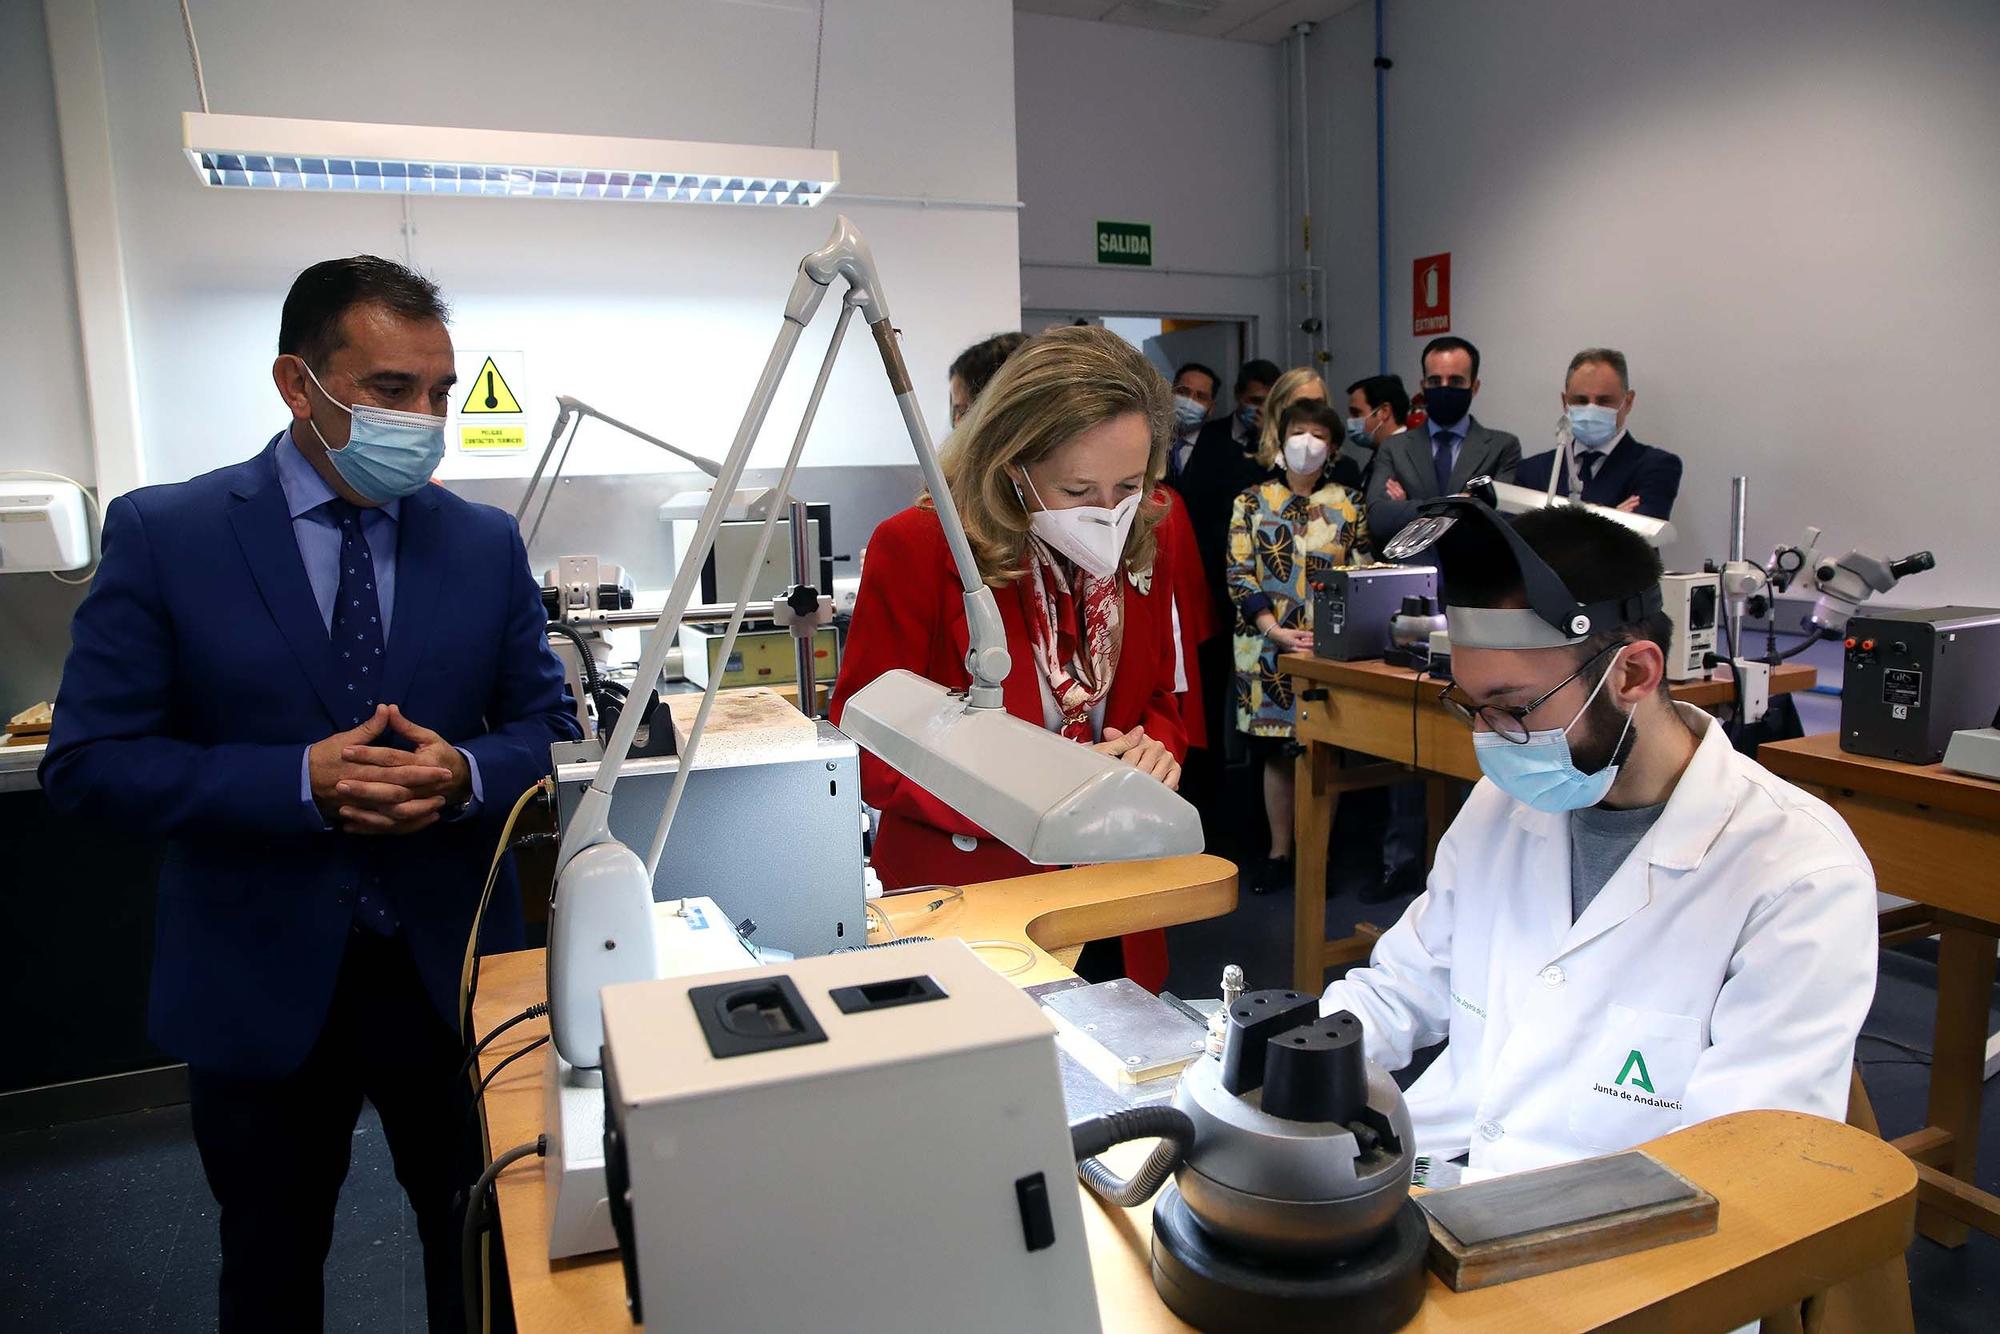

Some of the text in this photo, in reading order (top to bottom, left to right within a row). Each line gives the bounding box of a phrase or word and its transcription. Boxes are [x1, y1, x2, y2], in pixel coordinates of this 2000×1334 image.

[1100, 232, 1149, 255] SALIDA
[1593, 1083, 1618, 1097] Junta
[1620, 1091, 1632, 1101] de
